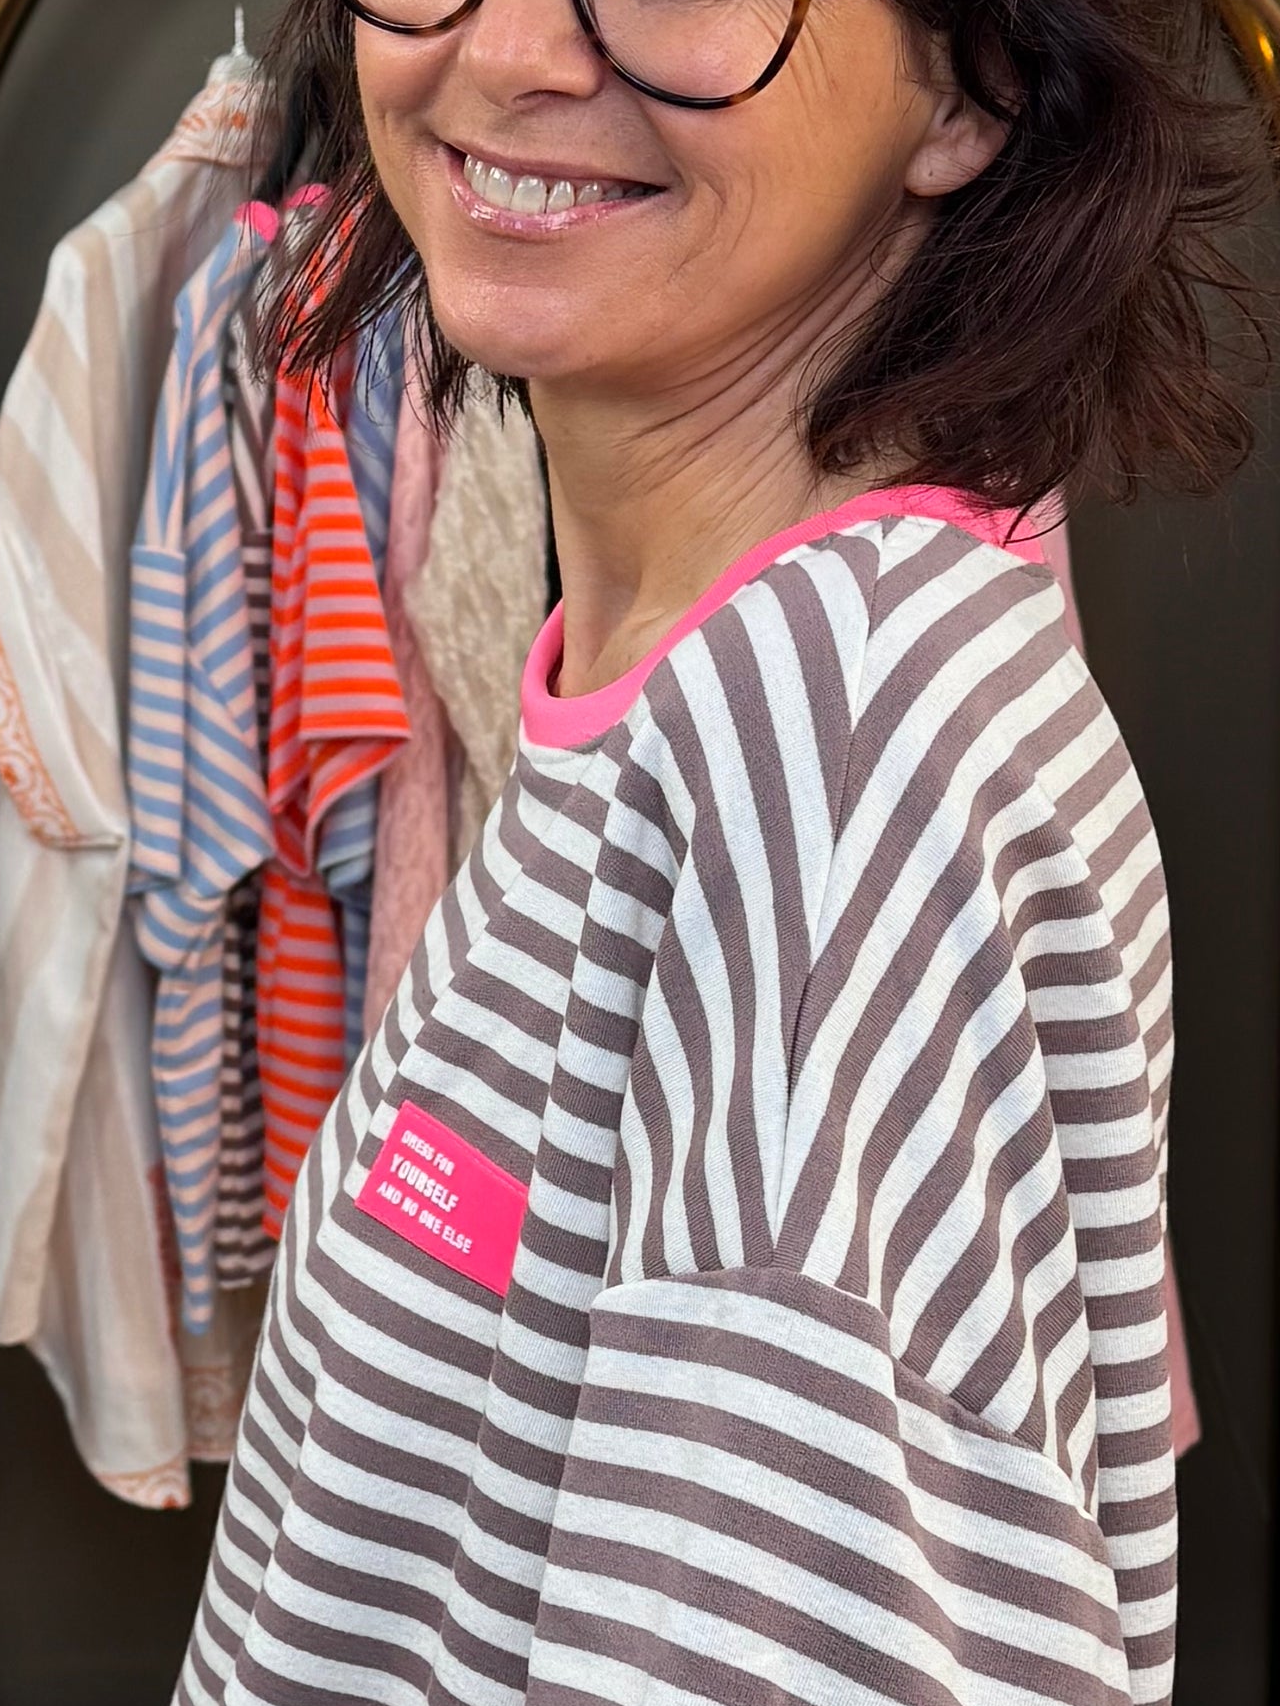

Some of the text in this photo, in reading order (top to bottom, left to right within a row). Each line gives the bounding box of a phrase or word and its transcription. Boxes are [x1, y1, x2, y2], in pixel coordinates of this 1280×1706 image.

[390, 1153, 459, 1212] YOURSELF
[401, 1130, 455, 1176] DRESS FOR
[376, 1181, 472, 1254] AND NO ONE ELSE
